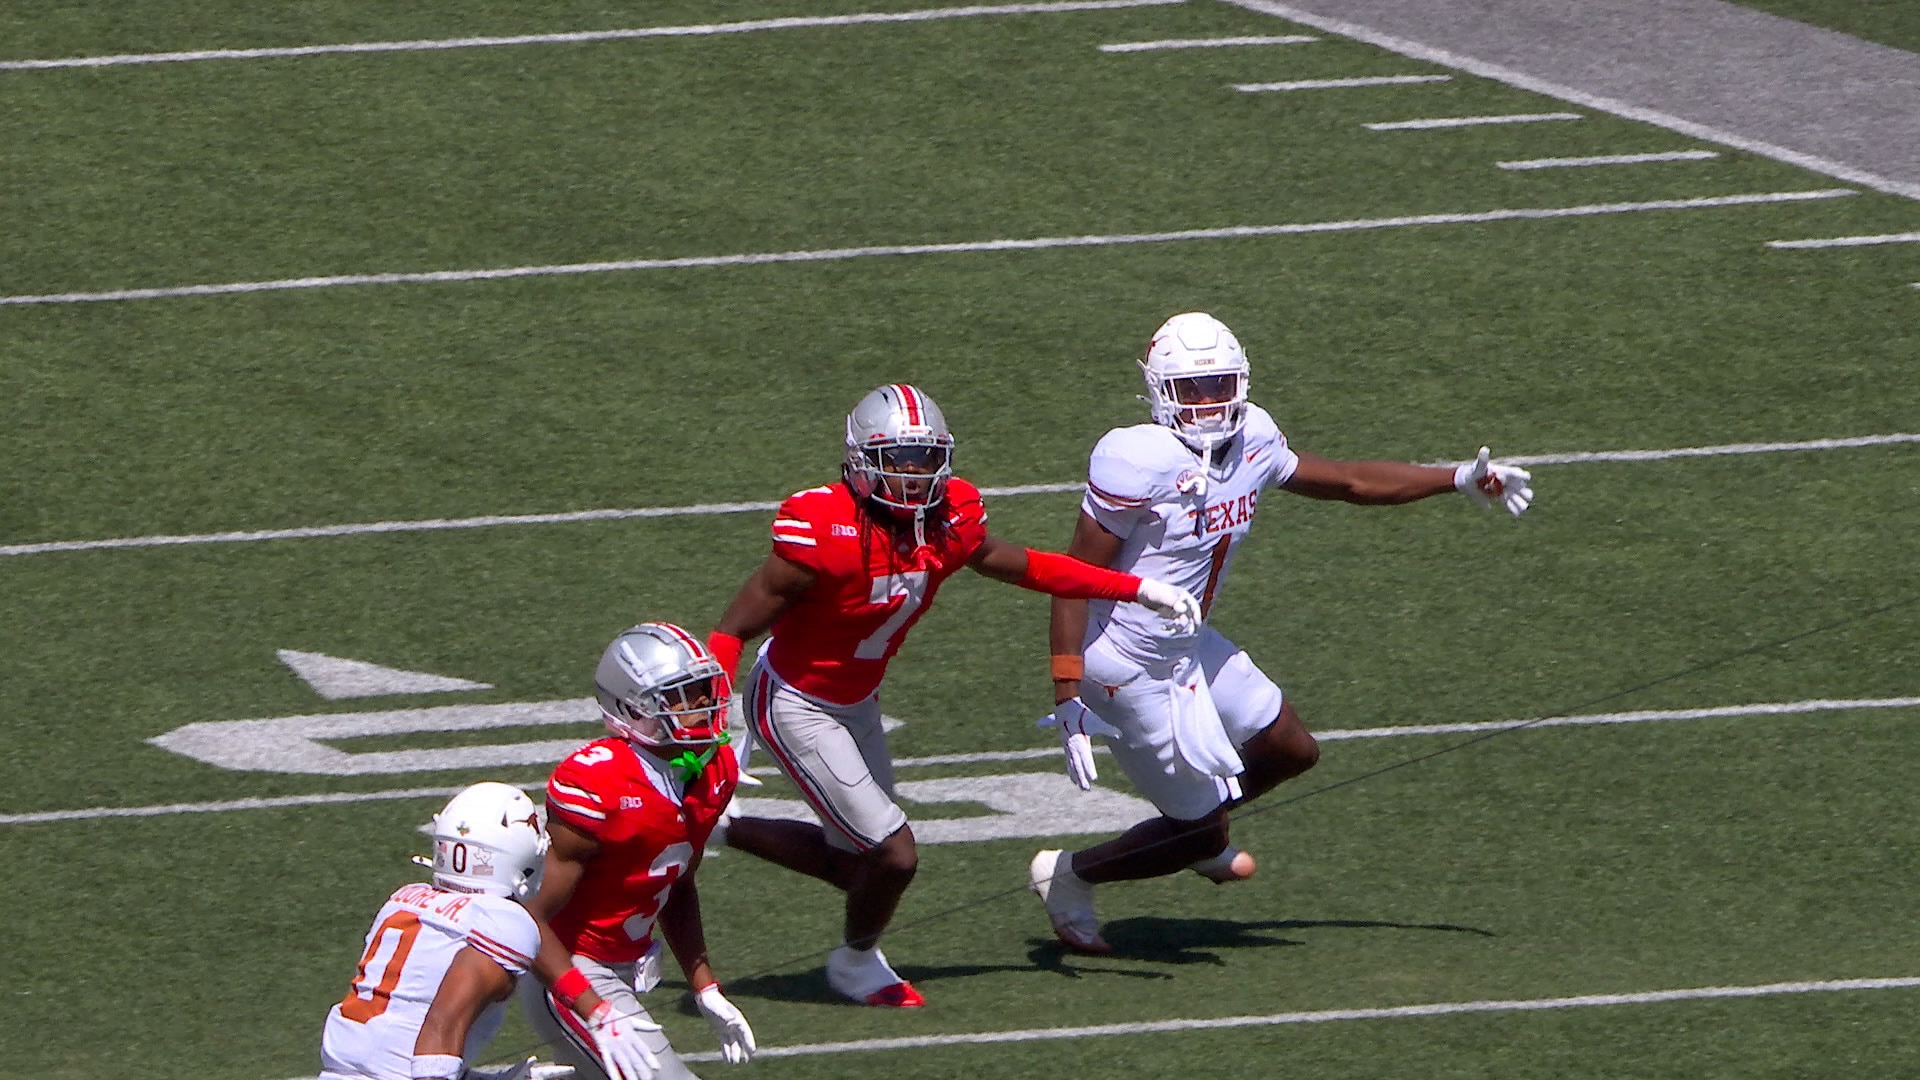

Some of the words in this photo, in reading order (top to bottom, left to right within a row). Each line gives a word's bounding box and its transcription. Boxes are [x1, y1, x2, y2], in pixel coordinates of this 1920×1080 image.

[1188, 489, 1258, 537] TEXAS
[1201, 533, 1232, 620] 1
[853, 571, 929, 660] 7
[573, 745, 614, 766] 3
[452, 842, 467, 874] 0
[622, 841, 694, 942] 3
[434, 896, 473, 923] JR.
[340, 909, 423, 1025] 0
